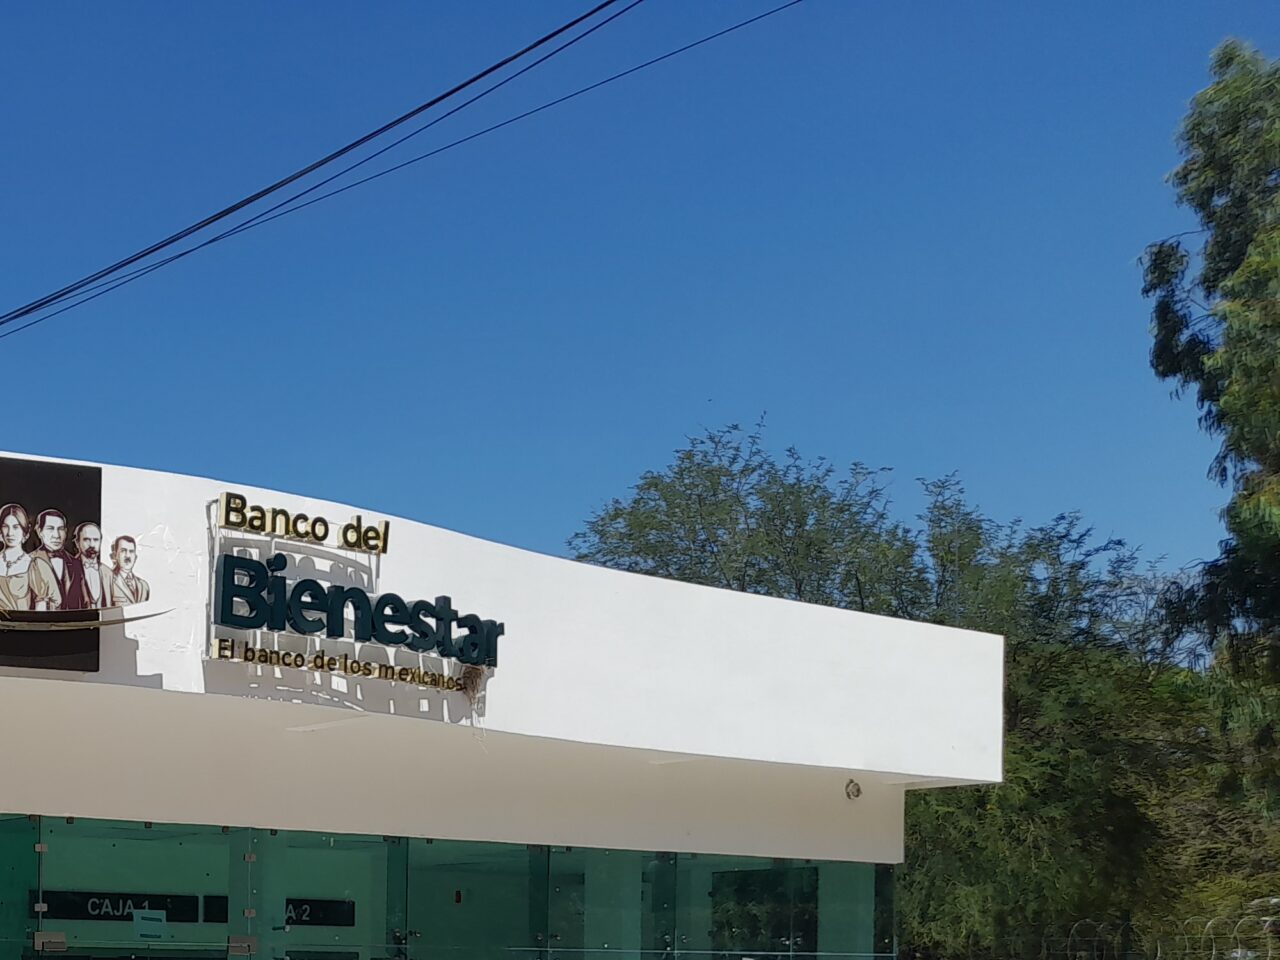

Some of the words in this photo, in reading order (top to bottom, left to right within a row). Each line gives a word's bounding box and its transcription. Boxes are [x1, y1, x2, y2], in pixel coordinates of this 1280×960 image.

[222, 491, 329, 542] Banco
[341, 515, 390, 554] del
[219, 553, 504, 667] Bienestar
[218, 638, 234, 659] El
[243, 641, 305, 668] banco
[313, 650, 337, 671] de
[343, 653, 372, 676] los
[378, 663, 466, 691] mexicanos
[87, 897, 135, 917] CAJA
[301, 904, 311, 921] 2
